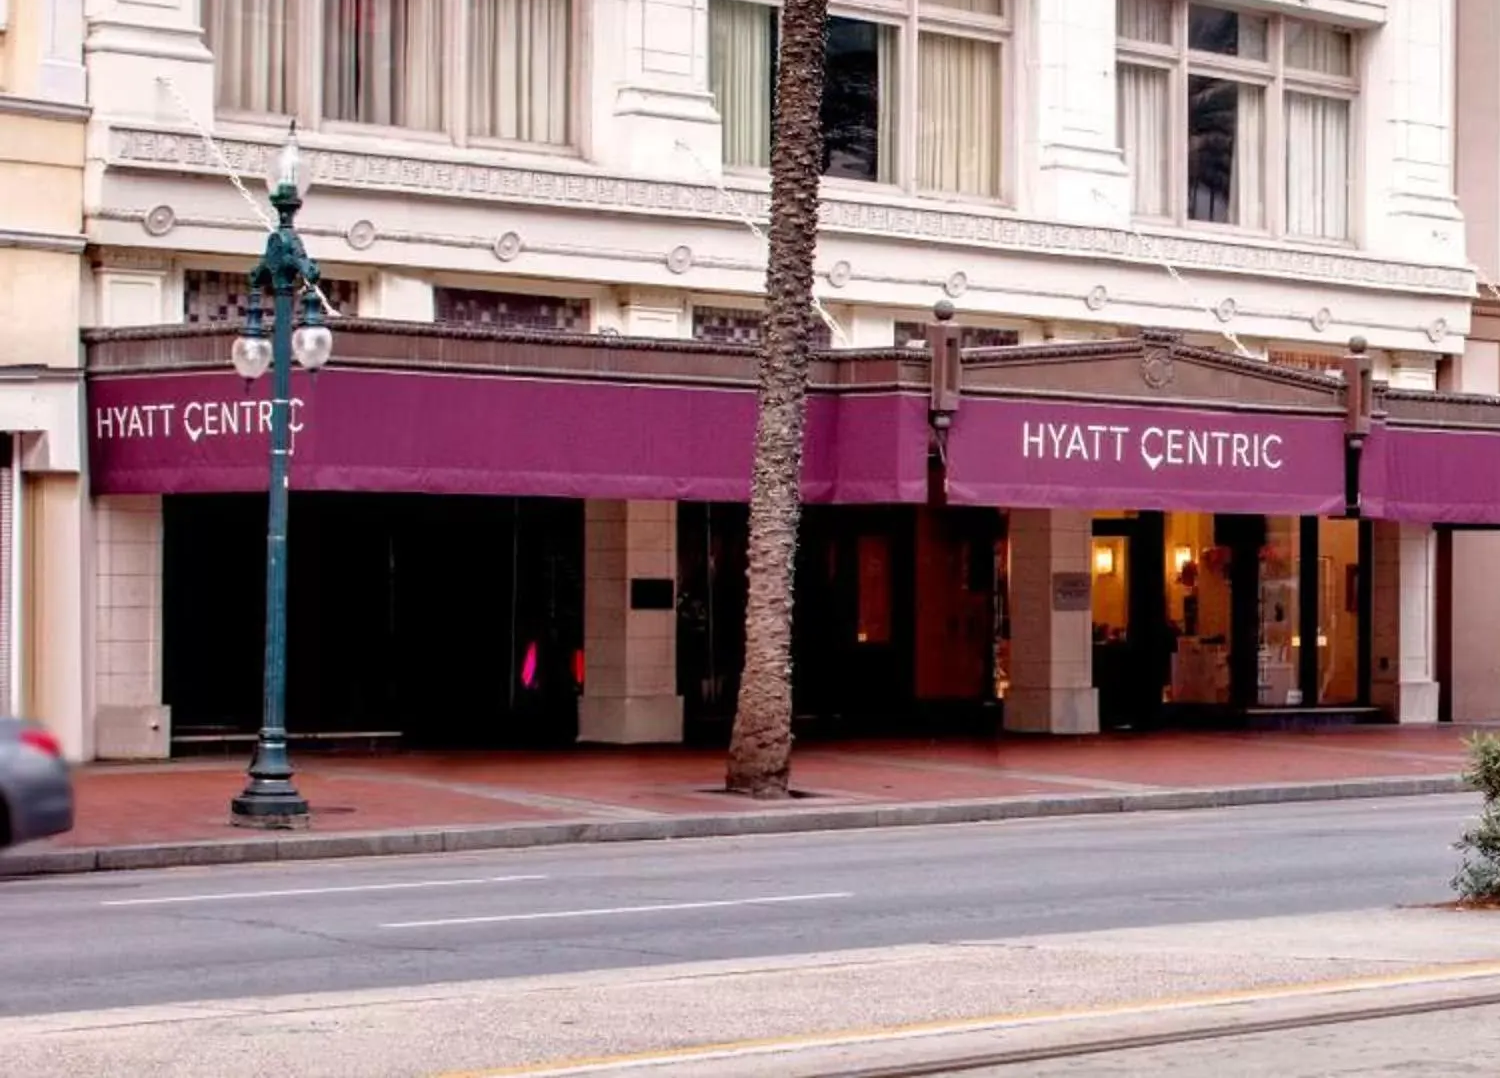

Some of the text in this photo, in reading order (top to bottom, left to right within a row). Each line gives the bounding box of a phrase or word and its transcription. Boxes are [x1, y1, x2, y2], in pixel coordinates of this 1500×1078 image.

[96, 397, 304, 442] HYATT CENTRC
[1022, 421, 1283, 471] HYATT CENTRIC
